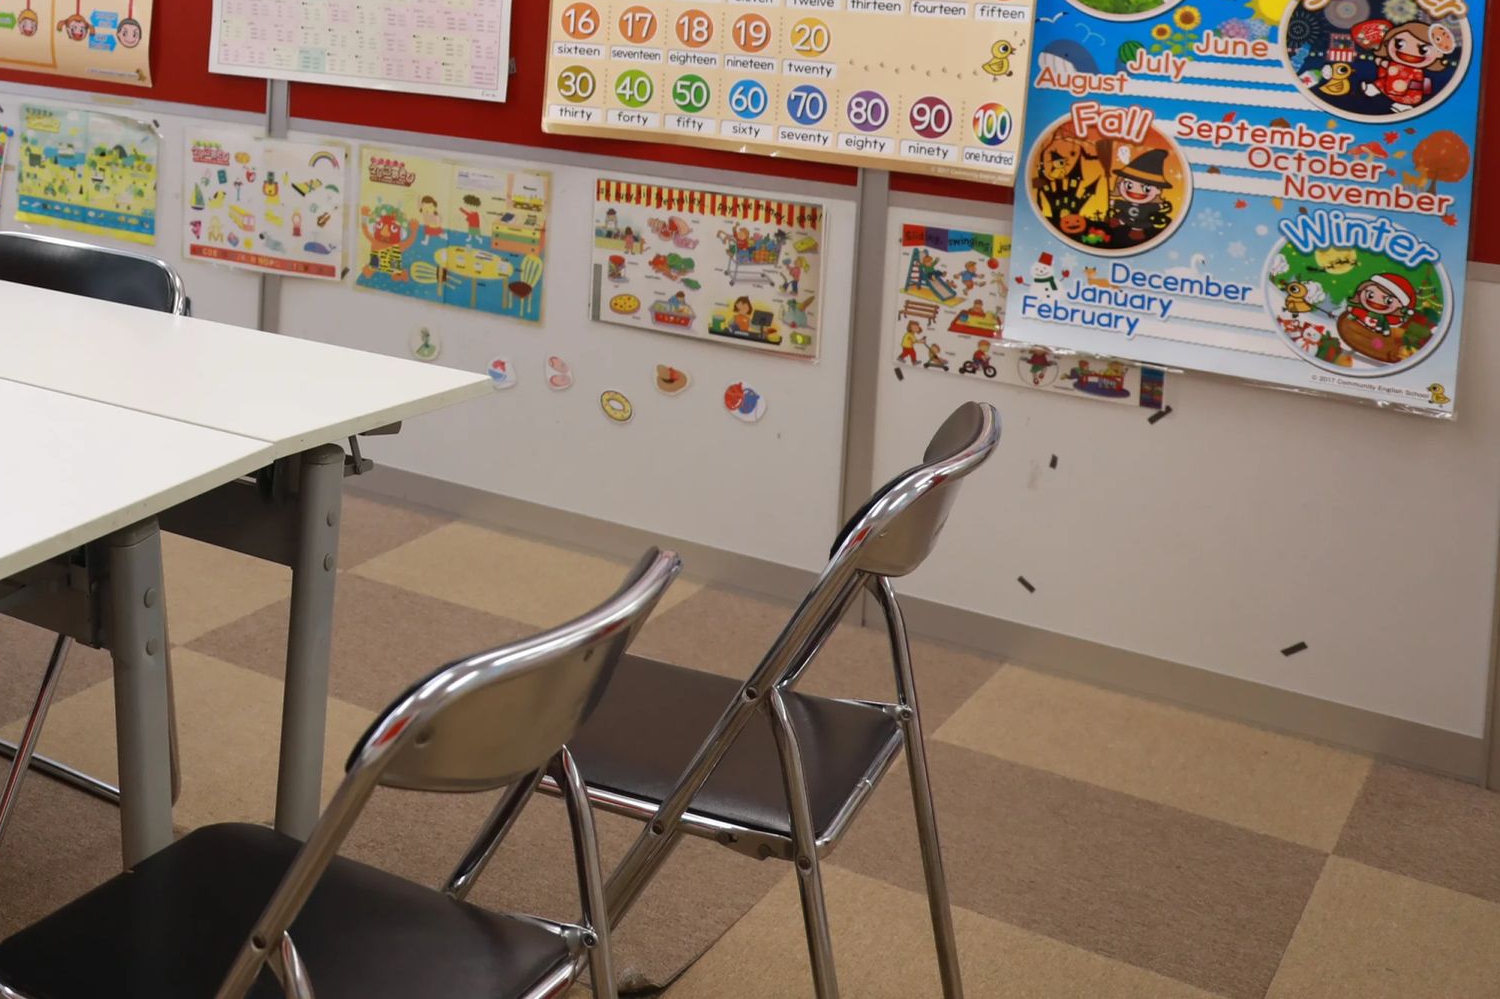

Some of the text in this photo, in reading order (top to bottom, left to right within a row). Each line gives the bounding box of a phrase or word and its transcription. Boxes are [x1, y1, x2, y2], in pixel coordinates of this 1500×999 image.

[851, 0, 901, 12] thirteen
[913, 2, 966, 16] fourteen
[980, 6, 1025, 20] fifteen
[565, 7, 596, 35] 16
[622, 11, 653, 39] 17
[678, 15, 709, 42] 18
[735, 19, 767, 47] 19
[557, 46, 600, 57] sixteen
[794, 24, 829, 52] 20
[1195, 31, 1269, 58] June
[612, 49, 661, 61] seventeen
[670, 53, 717, 66] eighteen
[726, 57, 774, 71] nineteen
[1128, 48, 1187, 80] July
[787, 62, 833, 78] twenty
[1036, 65, 1128, 95] August
[560, 71, 594, 98] 30
[616, 75, 650, 103] 40
[675, 80, 708, 108] 50
[731, 85, 765, 114] 60
[790, 91, 824, 120] 70
[850, 96, 886, 127] 80
[560, 107, 592, 121] thirty
[617, 112, 649, 125] forty
[676, 117, 704, 131] fifty
[912, 103, 949, 133] 90
[975, 109, 1011, 141] 100
[1070, 101, 1155, 144] Fall
[732, 124, 761, 138] sixty
[781, 130, 829, 145] seventy
[845, 137, 886, 152] eighty
[1176, 115, 1353, 153] September
[909, 144, 949, 159] ninety
[964, 152, 1013, 166] one hundred
[1248, 146, 1385, 182] October
[1283, 174, 1453, 216] November
[1279, 209, 1440, 267] Winter
[1111, 262, 1253, 302] December
[1067, 280, 1173, 317] January
[1022, 296, 1139, 336] February
